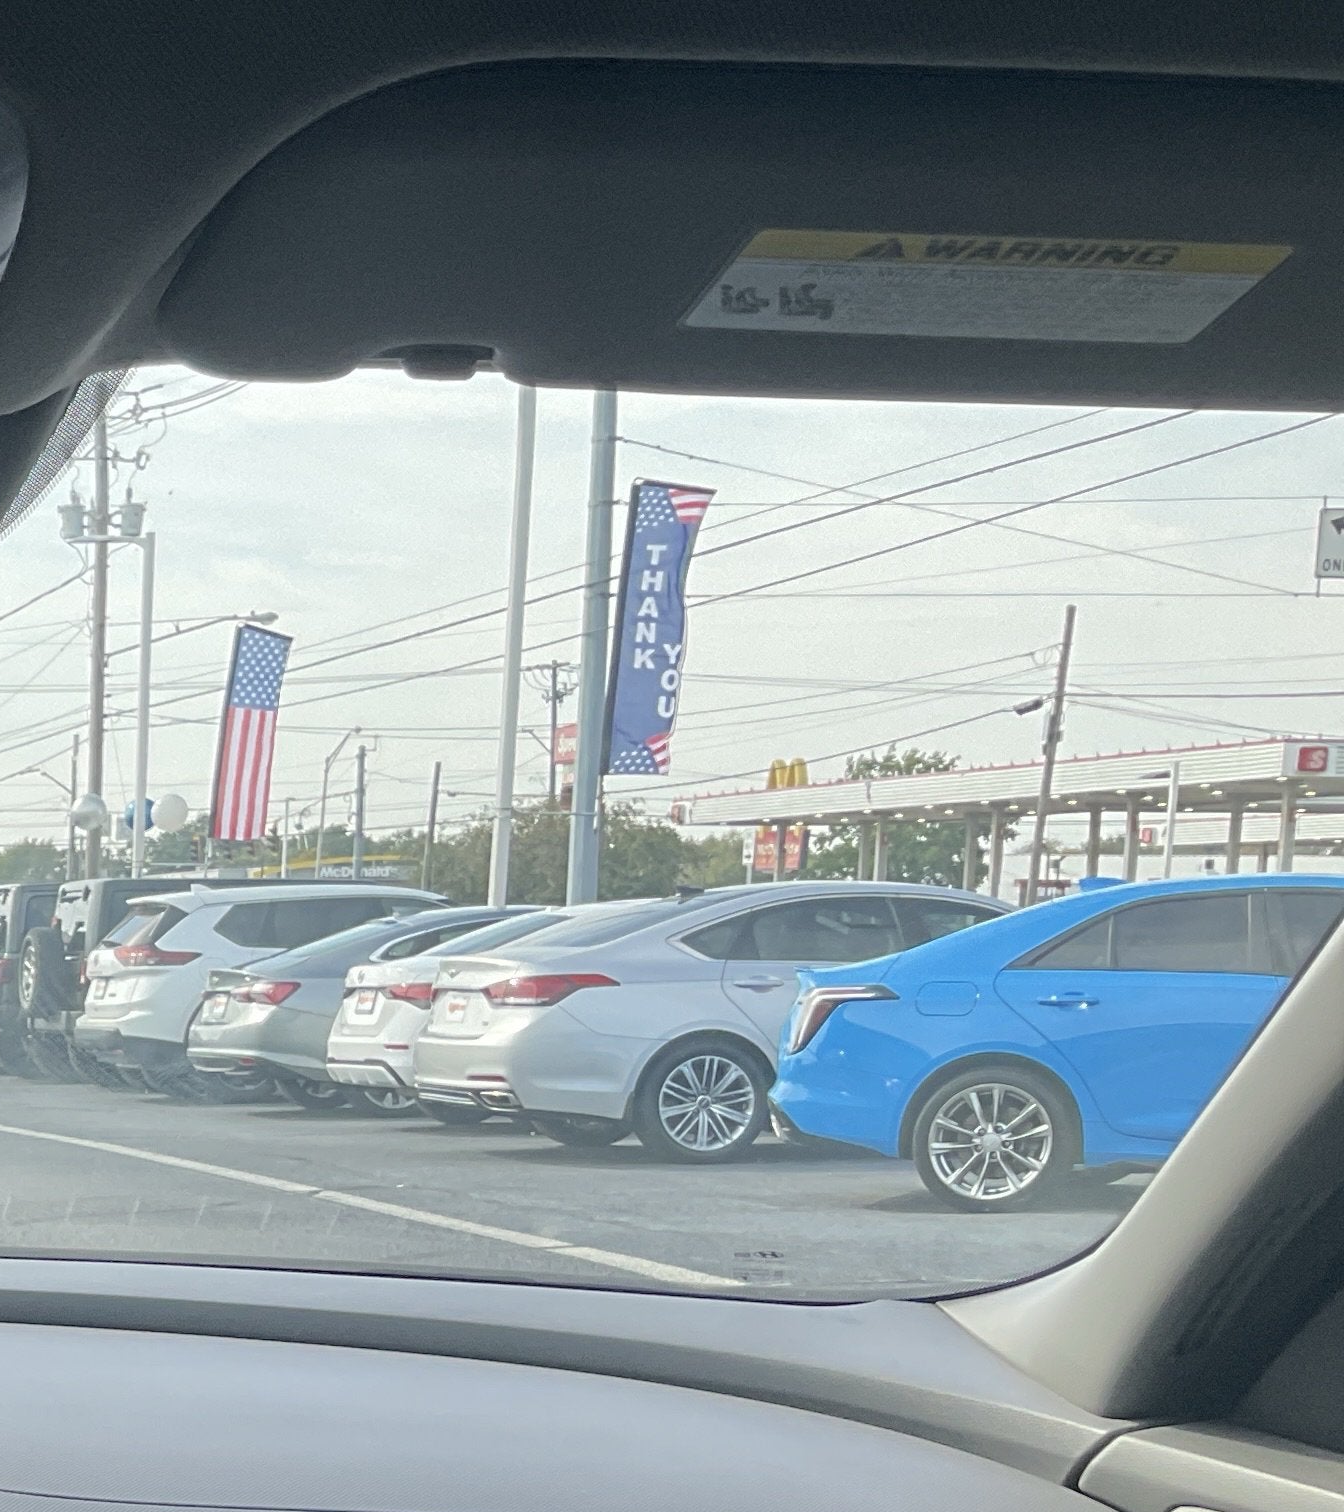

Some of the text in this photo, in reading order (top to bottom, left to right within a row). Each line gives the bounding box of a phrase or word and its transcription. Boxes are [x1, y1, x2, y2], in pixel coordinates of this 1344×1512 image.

[923, 238, 1180, 266] WARNING
[633, 543, 668, 670] THANK
[657, 642, 683, 718] YOU
[319, 865, 398, 878] McDnald's
